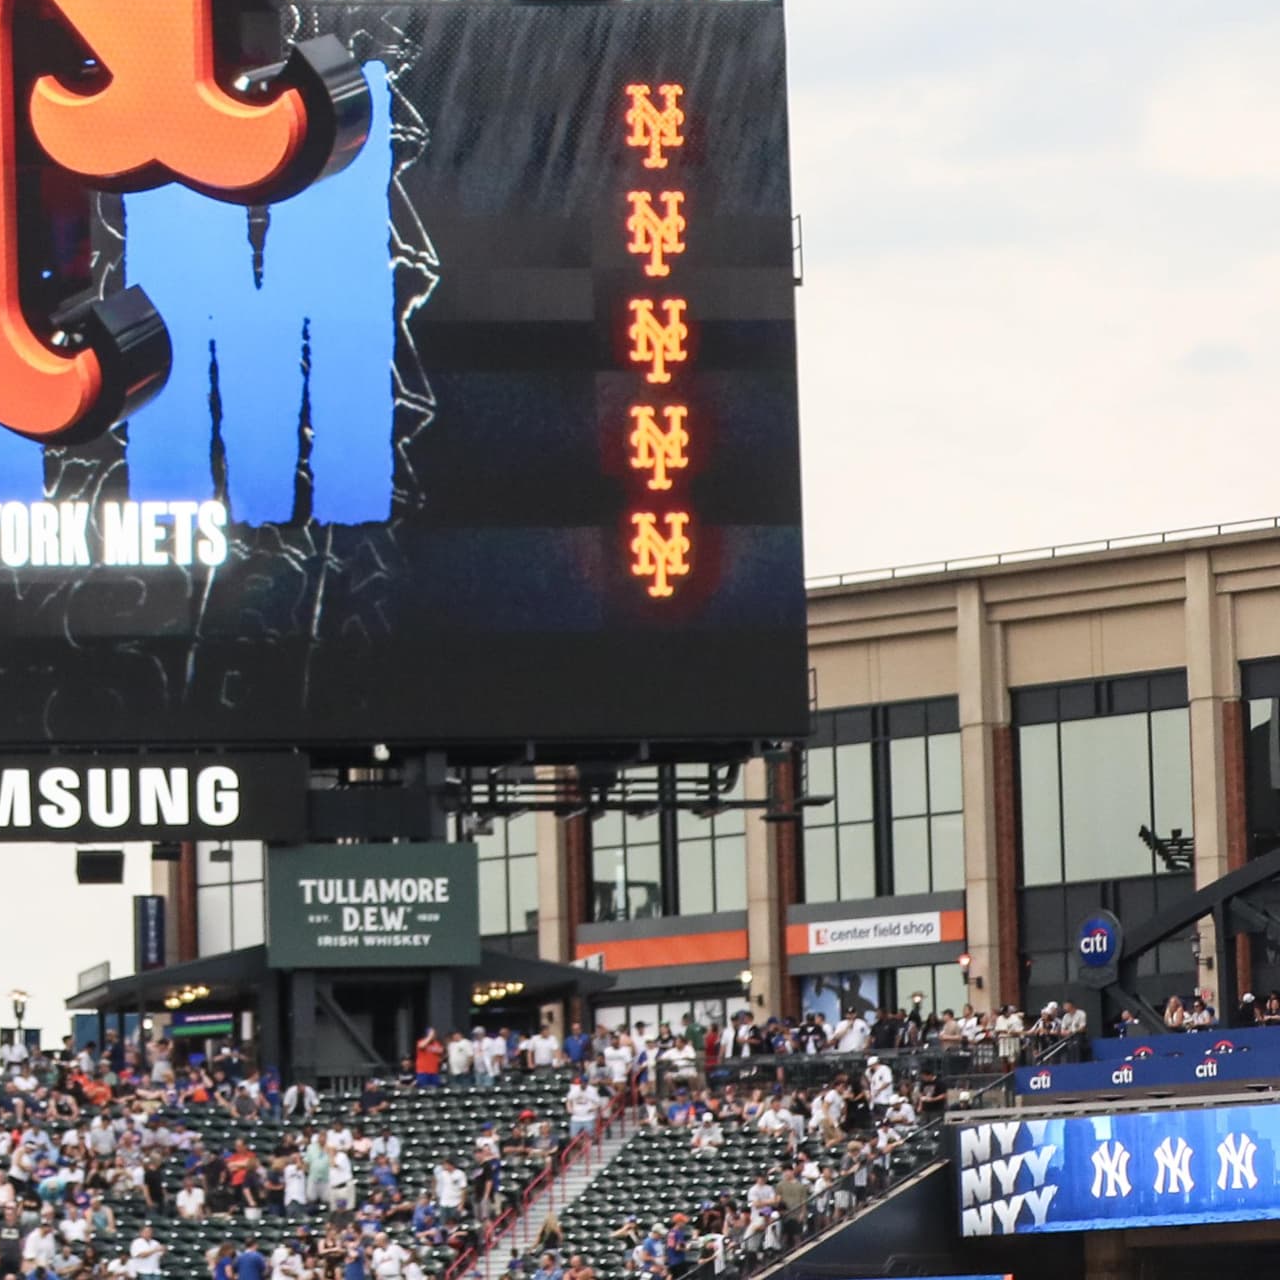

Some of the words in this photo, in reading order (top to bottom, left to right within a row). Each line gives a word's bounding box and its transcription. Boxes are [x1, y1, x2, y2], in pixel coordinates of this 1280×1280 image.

[102, 501, 228, 568] METS
[298, 877, 450, 905] TULLAMORE
[342, 906, 409, 932] D.E.W.
[317, 934, 359, 947] IRISH
[363, 933, 432, 947] WHISKEY
[830, 926, 871, 942] center
[873, 922, 901, 937] field
[903, 921, 935, 937] shop
[1080, 930, 1108, 953] citi
[1112, 1065, 1133, 1084] citi
[1195, 1059, 1217, 1078] citi
[1030, 1071, 1051, 1089] citi
[961, 1144, 1057, 1208] NYY
